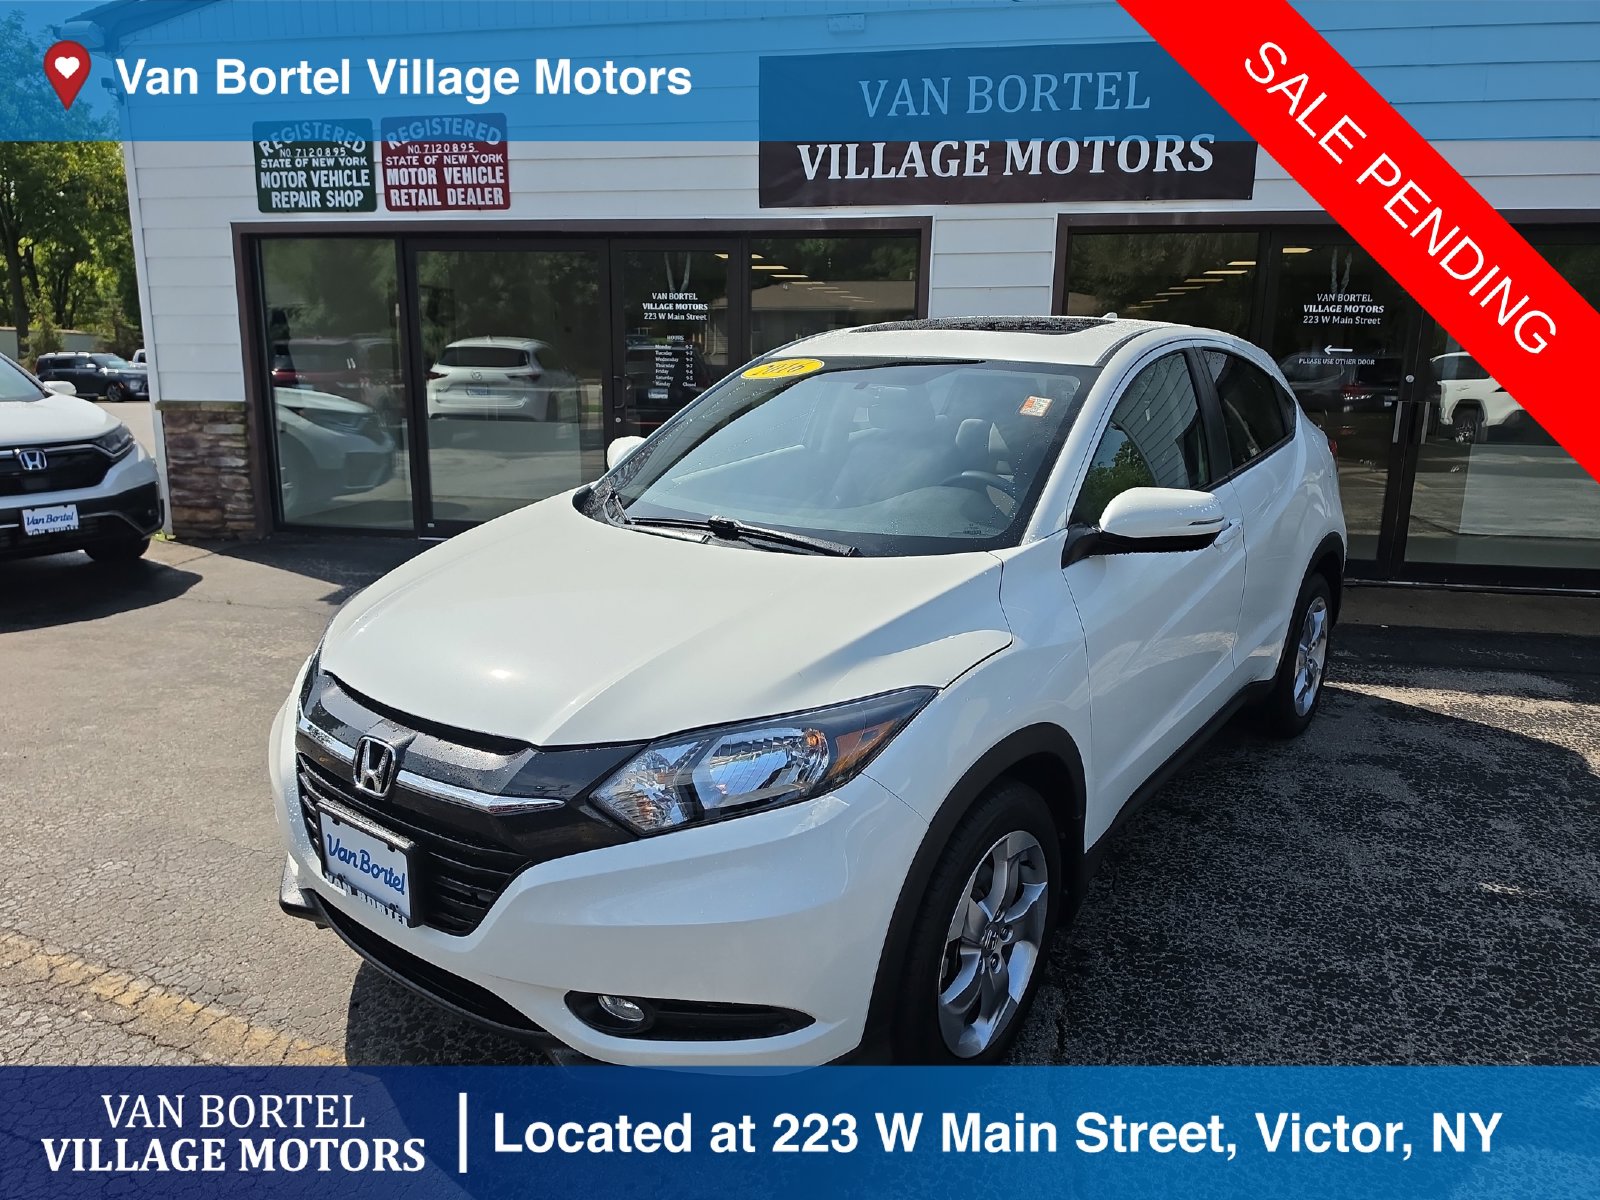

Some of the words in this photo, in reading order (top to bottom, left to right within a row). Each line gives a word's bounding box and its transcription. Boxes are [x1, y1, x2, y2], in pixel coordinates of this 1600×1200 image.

[859, 77, 951, 117] VAN
[967, 71, 1151, 114] BORTEL
[258, 121, 367, 156] REGISTERED
[385, 117, 502, 151] REGISTERED
[295, 147, 347, 157] 7120895
[423, 143, 475, 153] 7120895
[260, 158, 292, 169] STATE
[294, 158, 310, 168] OF
[312, 157, 337, 168] NEW
[338, 156, 368, 167] YORK
[385, 155, 421, 166] STATE
[424, 155, 439, 165] OF
[443, 154, 468, 165] NEW
[472, 153, 504, 164] YORK
[797, 140, 990, 180] VILLAGE
[1003, 134, 1215, 176] MOTORS
[260, 171, 307, 189] MOTOR
[310, 169, 371, 188] VEHICLE
[386, 167, 437, 186] MOTOR
[443, 166, 505, 185] VEHICLE
[271, 190, 321, 209] REPAIR
[325, 189, 365, 208] SHOP
[390, 188, 441, 207] RETAIL
[446, 188, 504, 206] DEALER
[1317, 293, 1335, 302] VAN
[1338, 293, 1373, 302] BORTEL
[676, 303, 708, 311] MOTORS
[1303, 304, 1342, 313] VILLAGE
[1344, 304, 1385, 314] MOTORS
[644, 312, 657, 320] 223
[659, 312, 666, 320] W
[668, 312, 685, 320] Main
[686, 313, 708, 321] Street
[1303, 315, 1319, 324] 223
[1321, 315, 1331, 324] W
[1333, 315, 1353, 325] Main
[1355, 316, 1381, 325] Street
